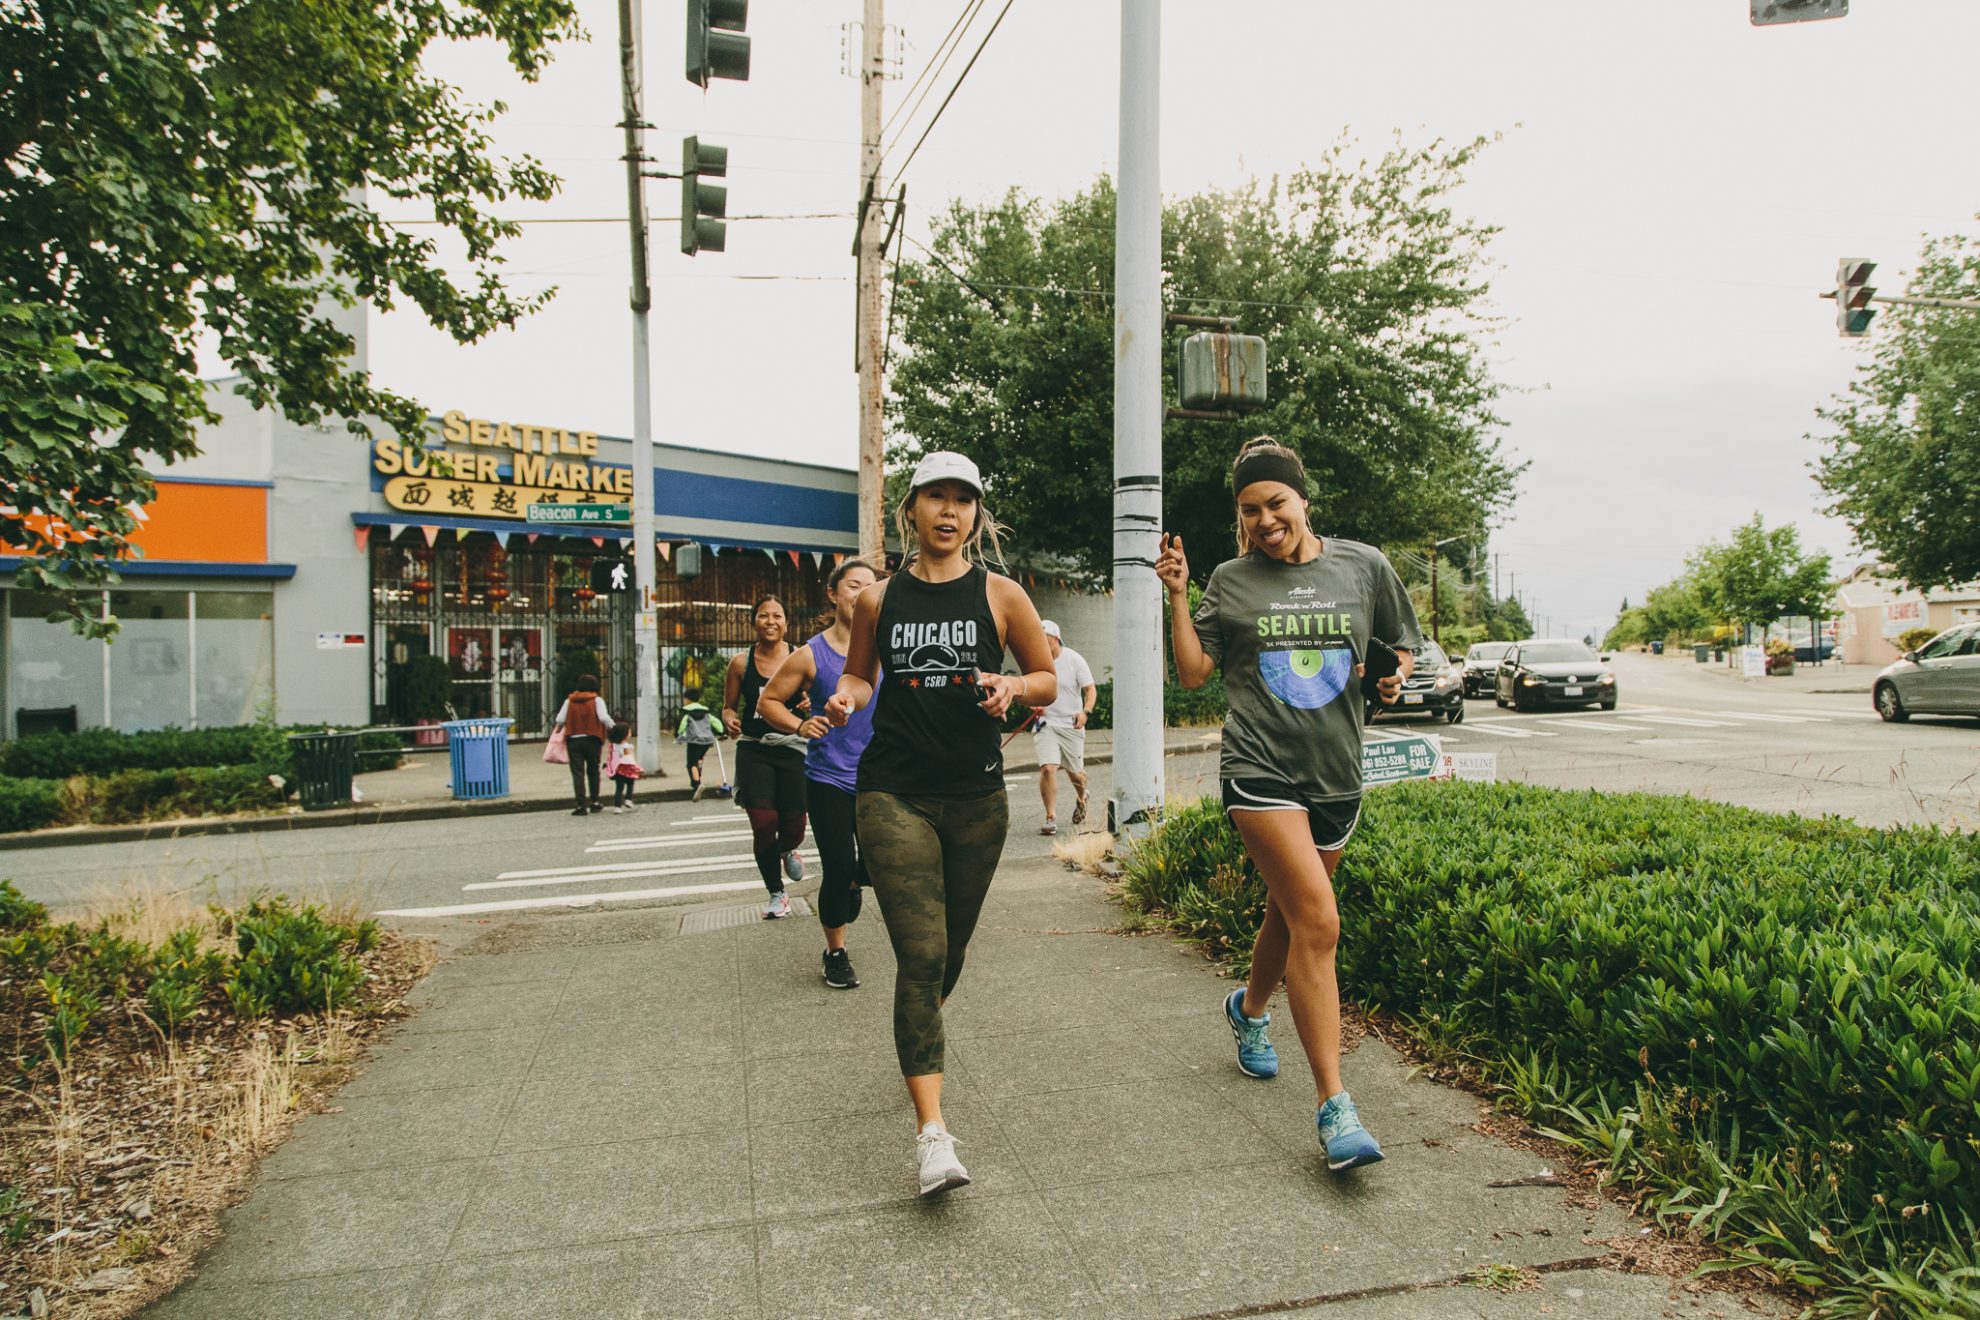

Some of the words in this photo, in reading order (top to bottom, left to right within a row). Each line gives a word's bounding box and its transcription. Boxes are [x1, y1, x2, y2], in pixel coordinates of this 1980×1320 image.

[443, 410, 598, 456] SEATTLE
[374, 439, 500, 483] SUPER
[513, 453, 633, 494] MARKE
[529, 505, 577, 520] Beacon
[581, 509, 599, 520] Ave
[605, 508, 614, 520] S
[1257, 613, 1352, 637] SEATTLE
[891, 620, 978, 649] CHICAGO
[924, 675, 948, 688] CSRD
[1363, 745, 1380, 757] Paul
[1381, 745, 1396, 755] Lau
[1409, 744, 1427, 757] FOR
[1409, 757, 1431, 771] SALE
[1458, 758, 1494, 769] SKYLINE
